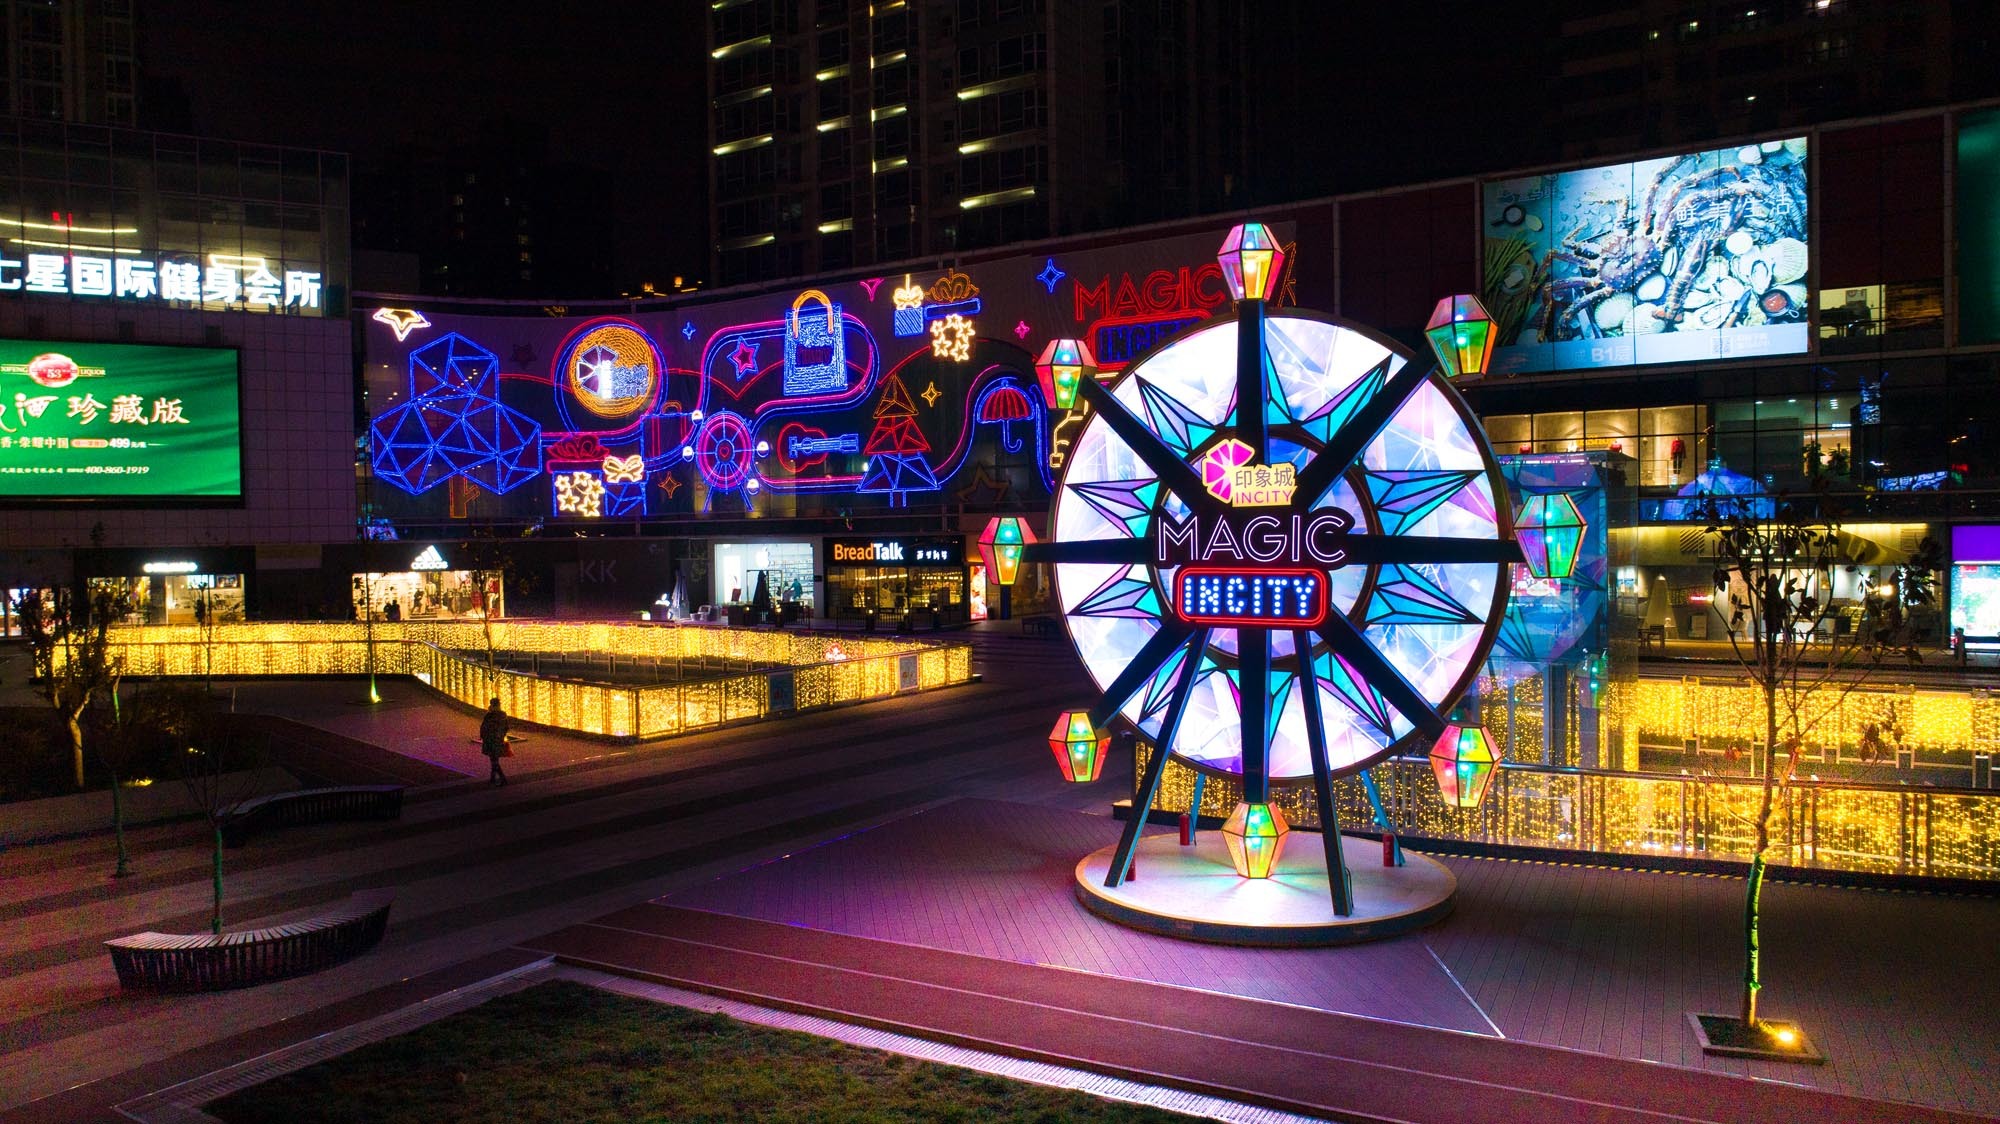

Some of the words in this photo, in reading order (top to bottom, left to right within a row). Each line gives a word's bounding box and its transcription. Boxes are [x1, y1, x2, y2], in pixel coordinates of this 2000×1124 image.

[1074, 263, 1226, 322] MAGIC
[66, 393, 190, 425] 珍藏版
[84, 465, 149, 475] 400-860-1919
[1235, 466, 1294, 488] 印象城
[1235, 489, 1292, 505] INCITY
[834, 541, 905, 561] BreadTalk
[1158, 514, 1346, 564] MAGIC
[1184, 576, 1316, 616] INCITY
